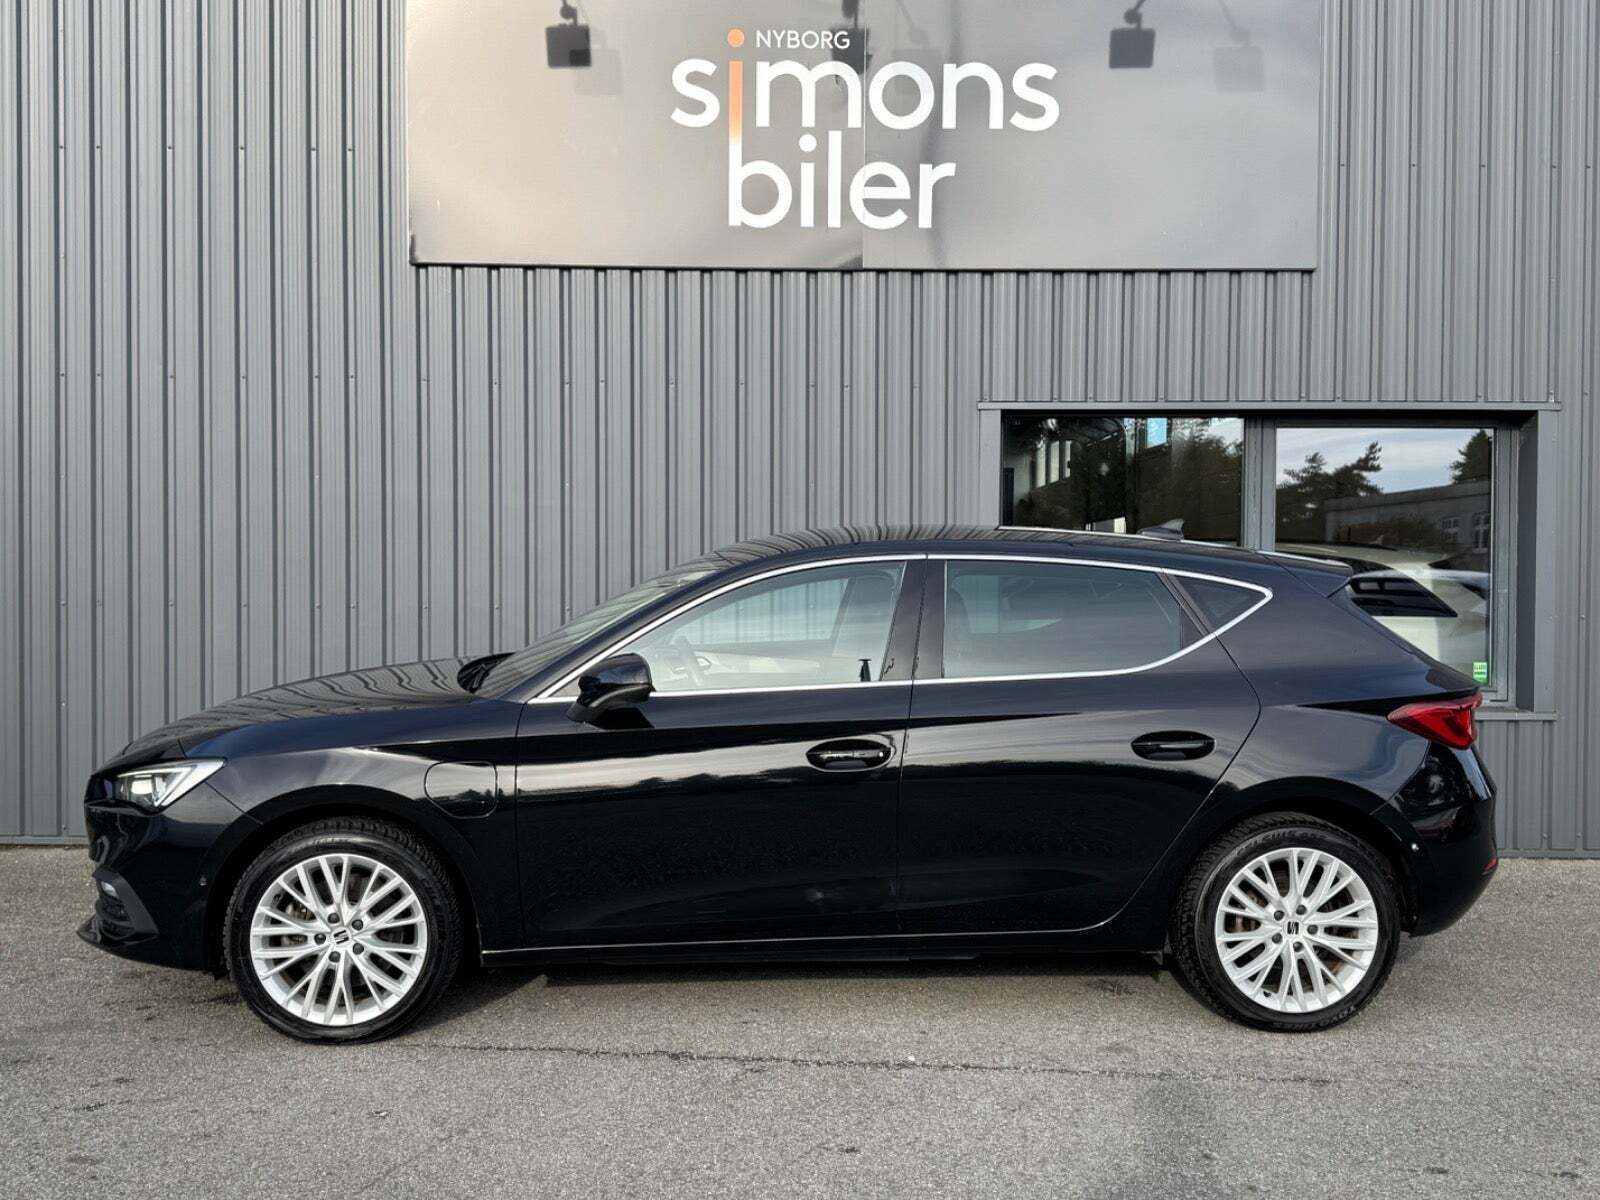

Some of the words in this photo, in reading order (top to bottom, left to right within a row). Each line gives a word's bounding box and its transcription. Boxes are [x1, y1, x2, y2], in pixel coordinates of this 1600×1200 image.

[670, 28, 1061, 132] simons
[755, 29, 851, 50] NYBORG
[728, 130, 957, 230] biler
